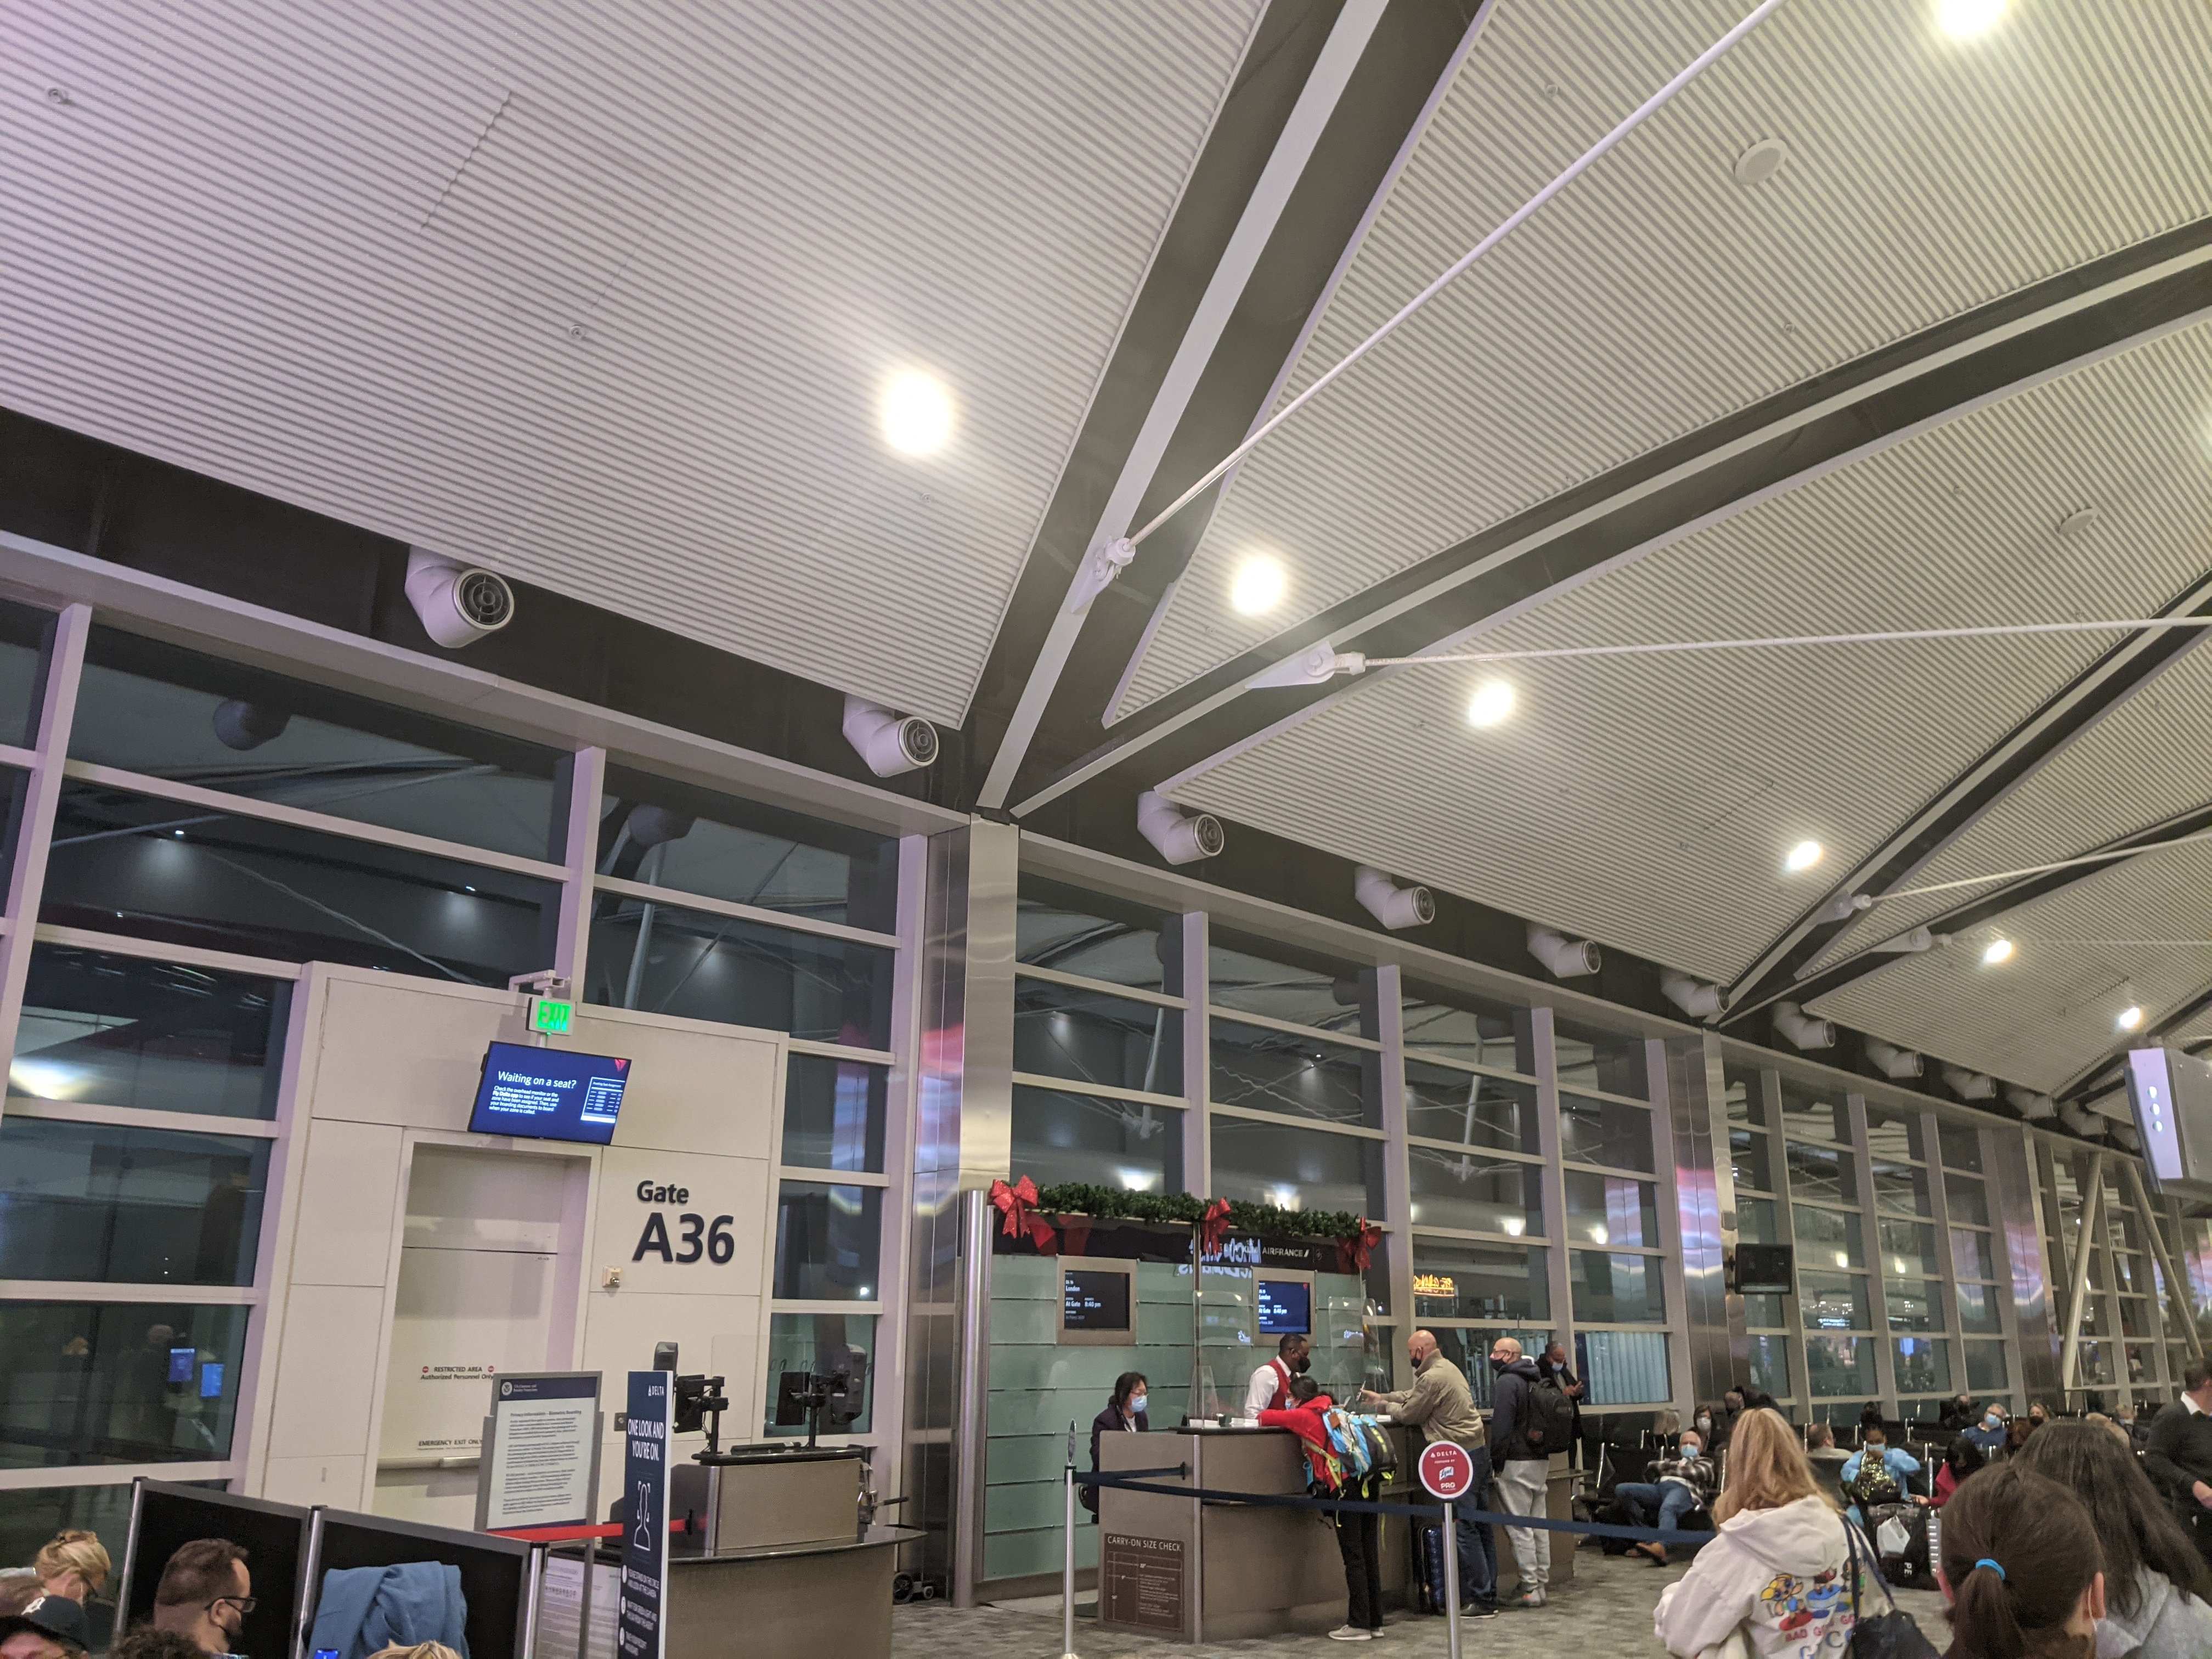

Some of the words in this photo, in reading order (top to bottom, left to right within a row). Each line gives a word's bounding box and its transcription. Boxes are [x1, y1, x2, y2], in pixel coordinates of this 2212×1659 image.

[537, 1001, 571, 1032] EXIT
[498, 1070, 532, 1086] Waiting
[553, 1080, 577, 1089] seat?
[637, 1180, 689, 1204] Gate
[632, 1212, 735, 1263] A36
[1262, 1247, 1304, 1257] AIRFRANCE
[652, 1386, 664, 1396] DELTA
[628, 1419, 638, 1436] ONE
[639, 1420, 652, 1438] LOOK
[653, 1421, 664, 1440] AND
[632, 1440, 650, 1460] YOU'RE
[650, 1442, 659, 1461] ON.
[1441, 1468, 1452, 1477] Lysol
[1108, 1536, 1141, 1547] CARRY-ON
[1143, 1540, 1157, 1549] SIZE
[1159, 1542, 1181, 1551] CHECK
